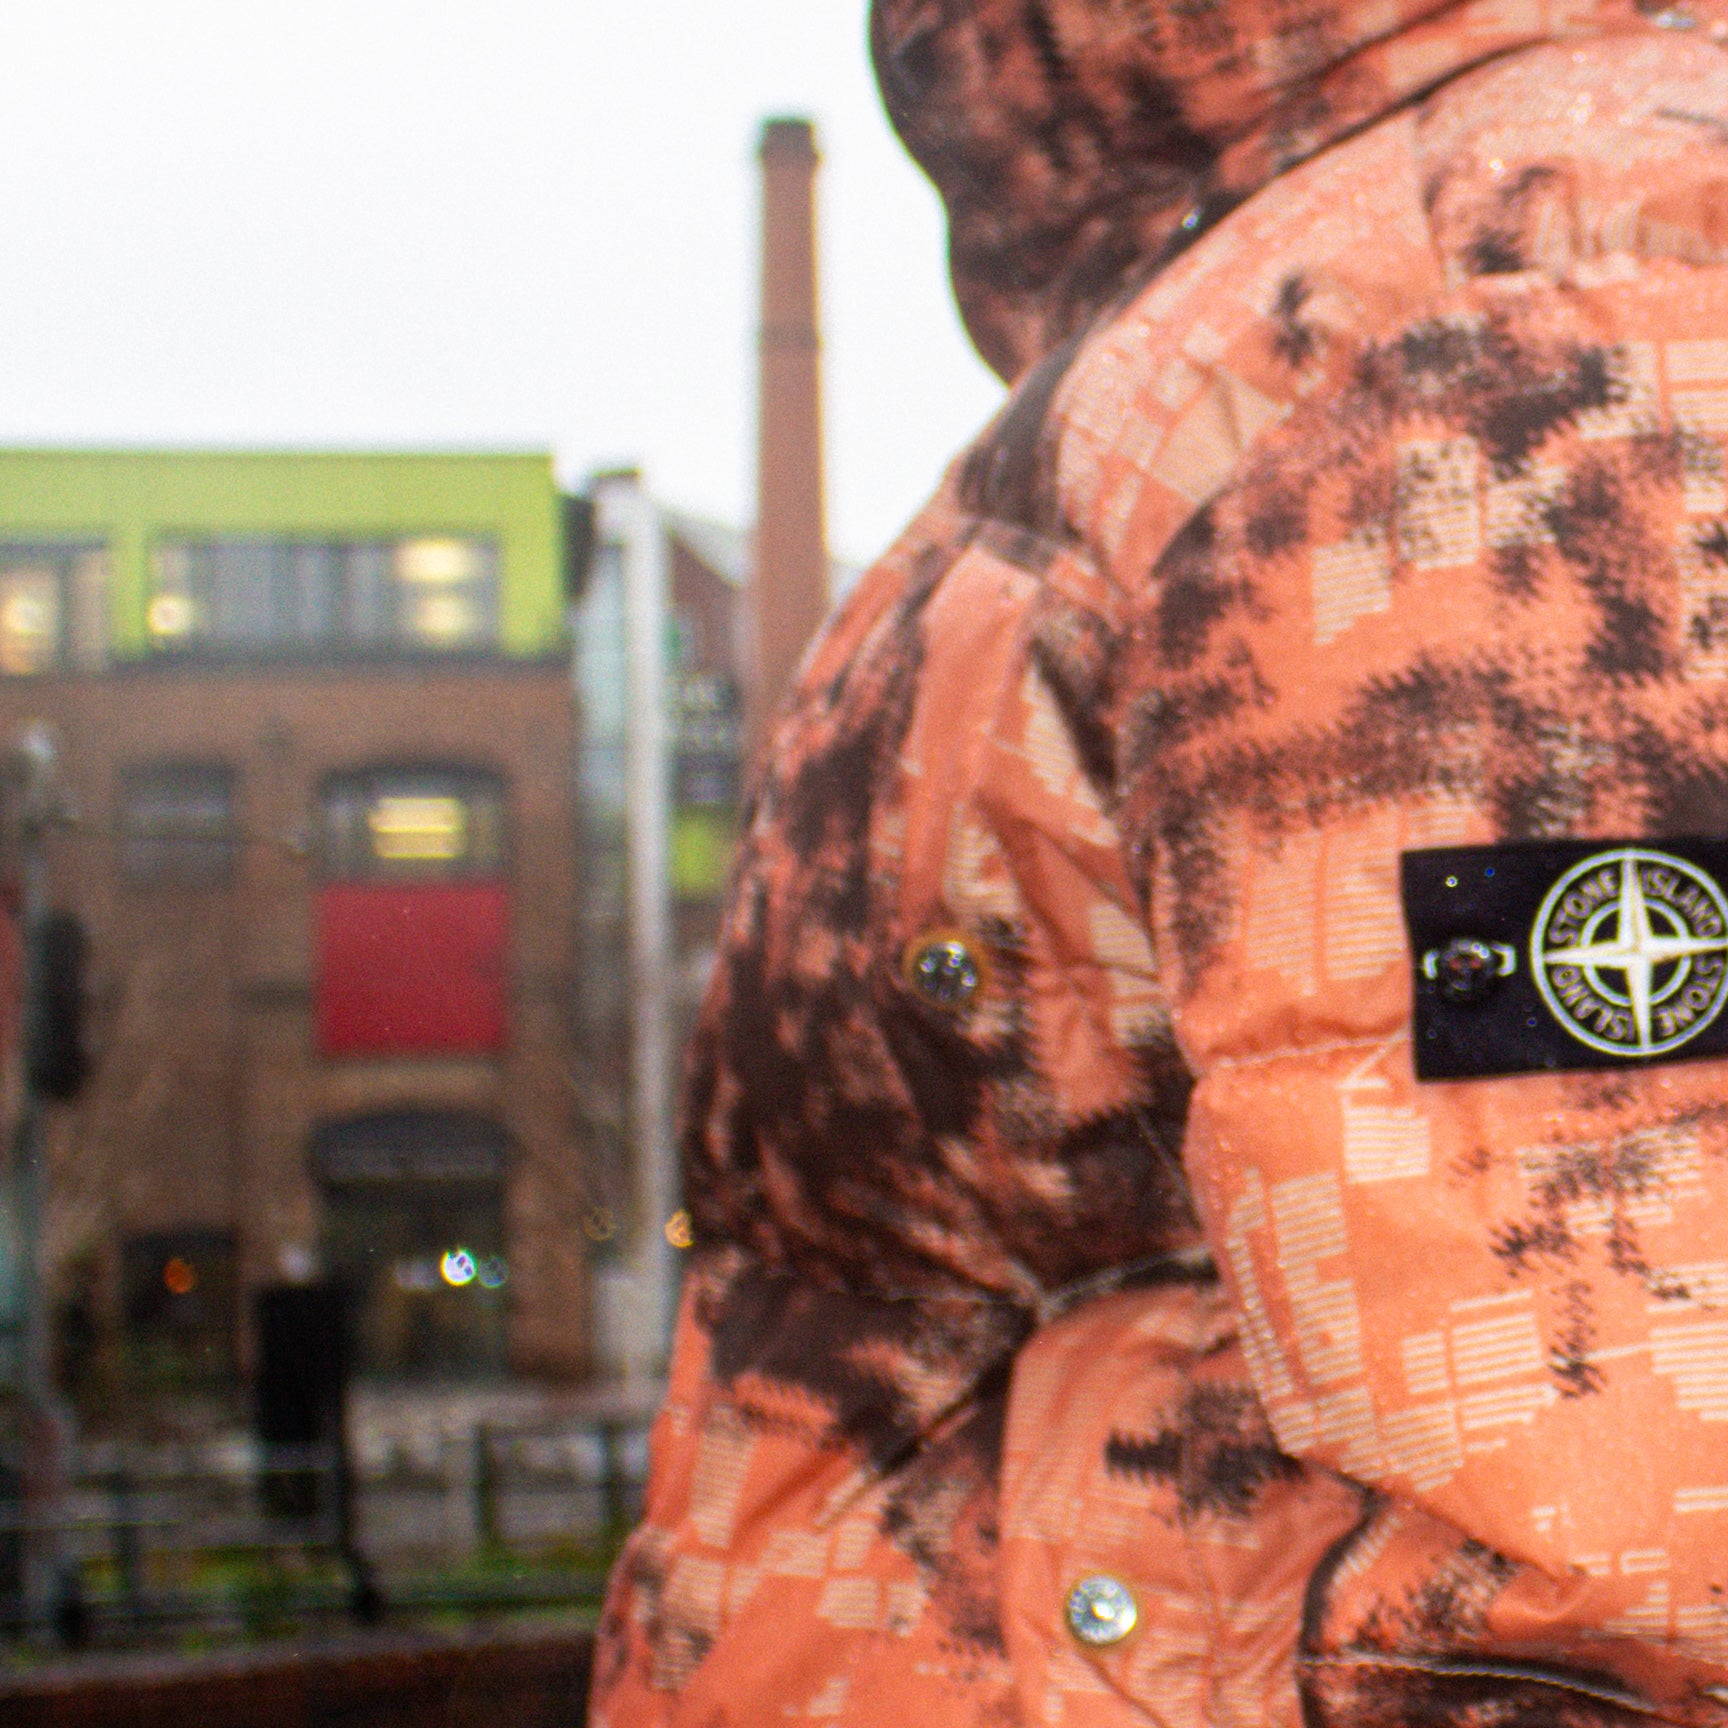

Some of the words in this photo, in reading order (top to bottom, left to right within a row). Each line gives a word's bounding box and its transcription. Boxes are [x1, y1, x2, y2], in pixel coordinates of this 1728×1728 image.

[1549, 868, 1618, 947] STONE
[1640, 868, 1722, 938] ISLAND
[1551, 965, 1635, 1041] ISLAND
[1655, 955, 1725, 1036] STONE
